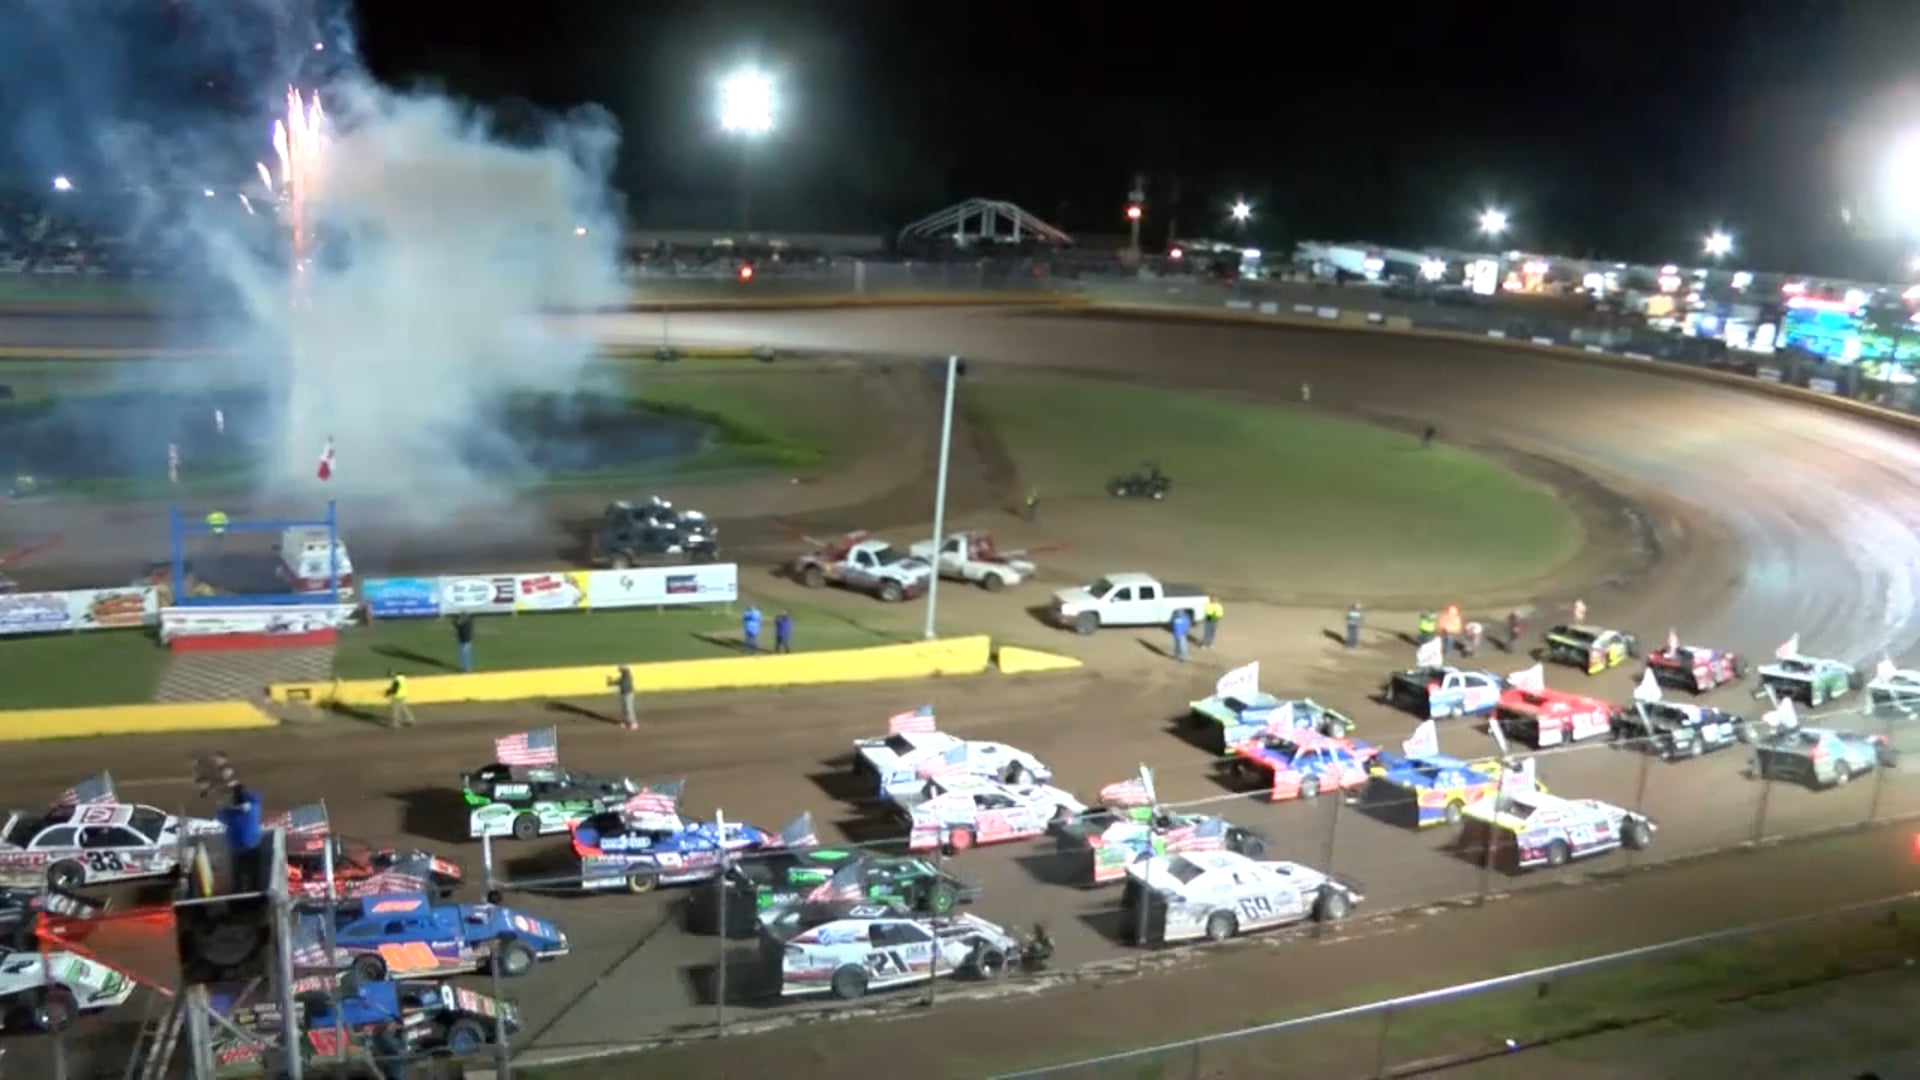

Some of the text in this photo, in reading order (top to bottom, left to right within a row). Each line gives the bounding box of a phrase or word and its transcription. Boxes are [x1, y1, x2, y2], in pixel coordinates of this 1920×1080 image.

[87, 851, 123, 872] 33
[1239, 895, 1273, 920] 69
[864, 948, 913, 979] 21
